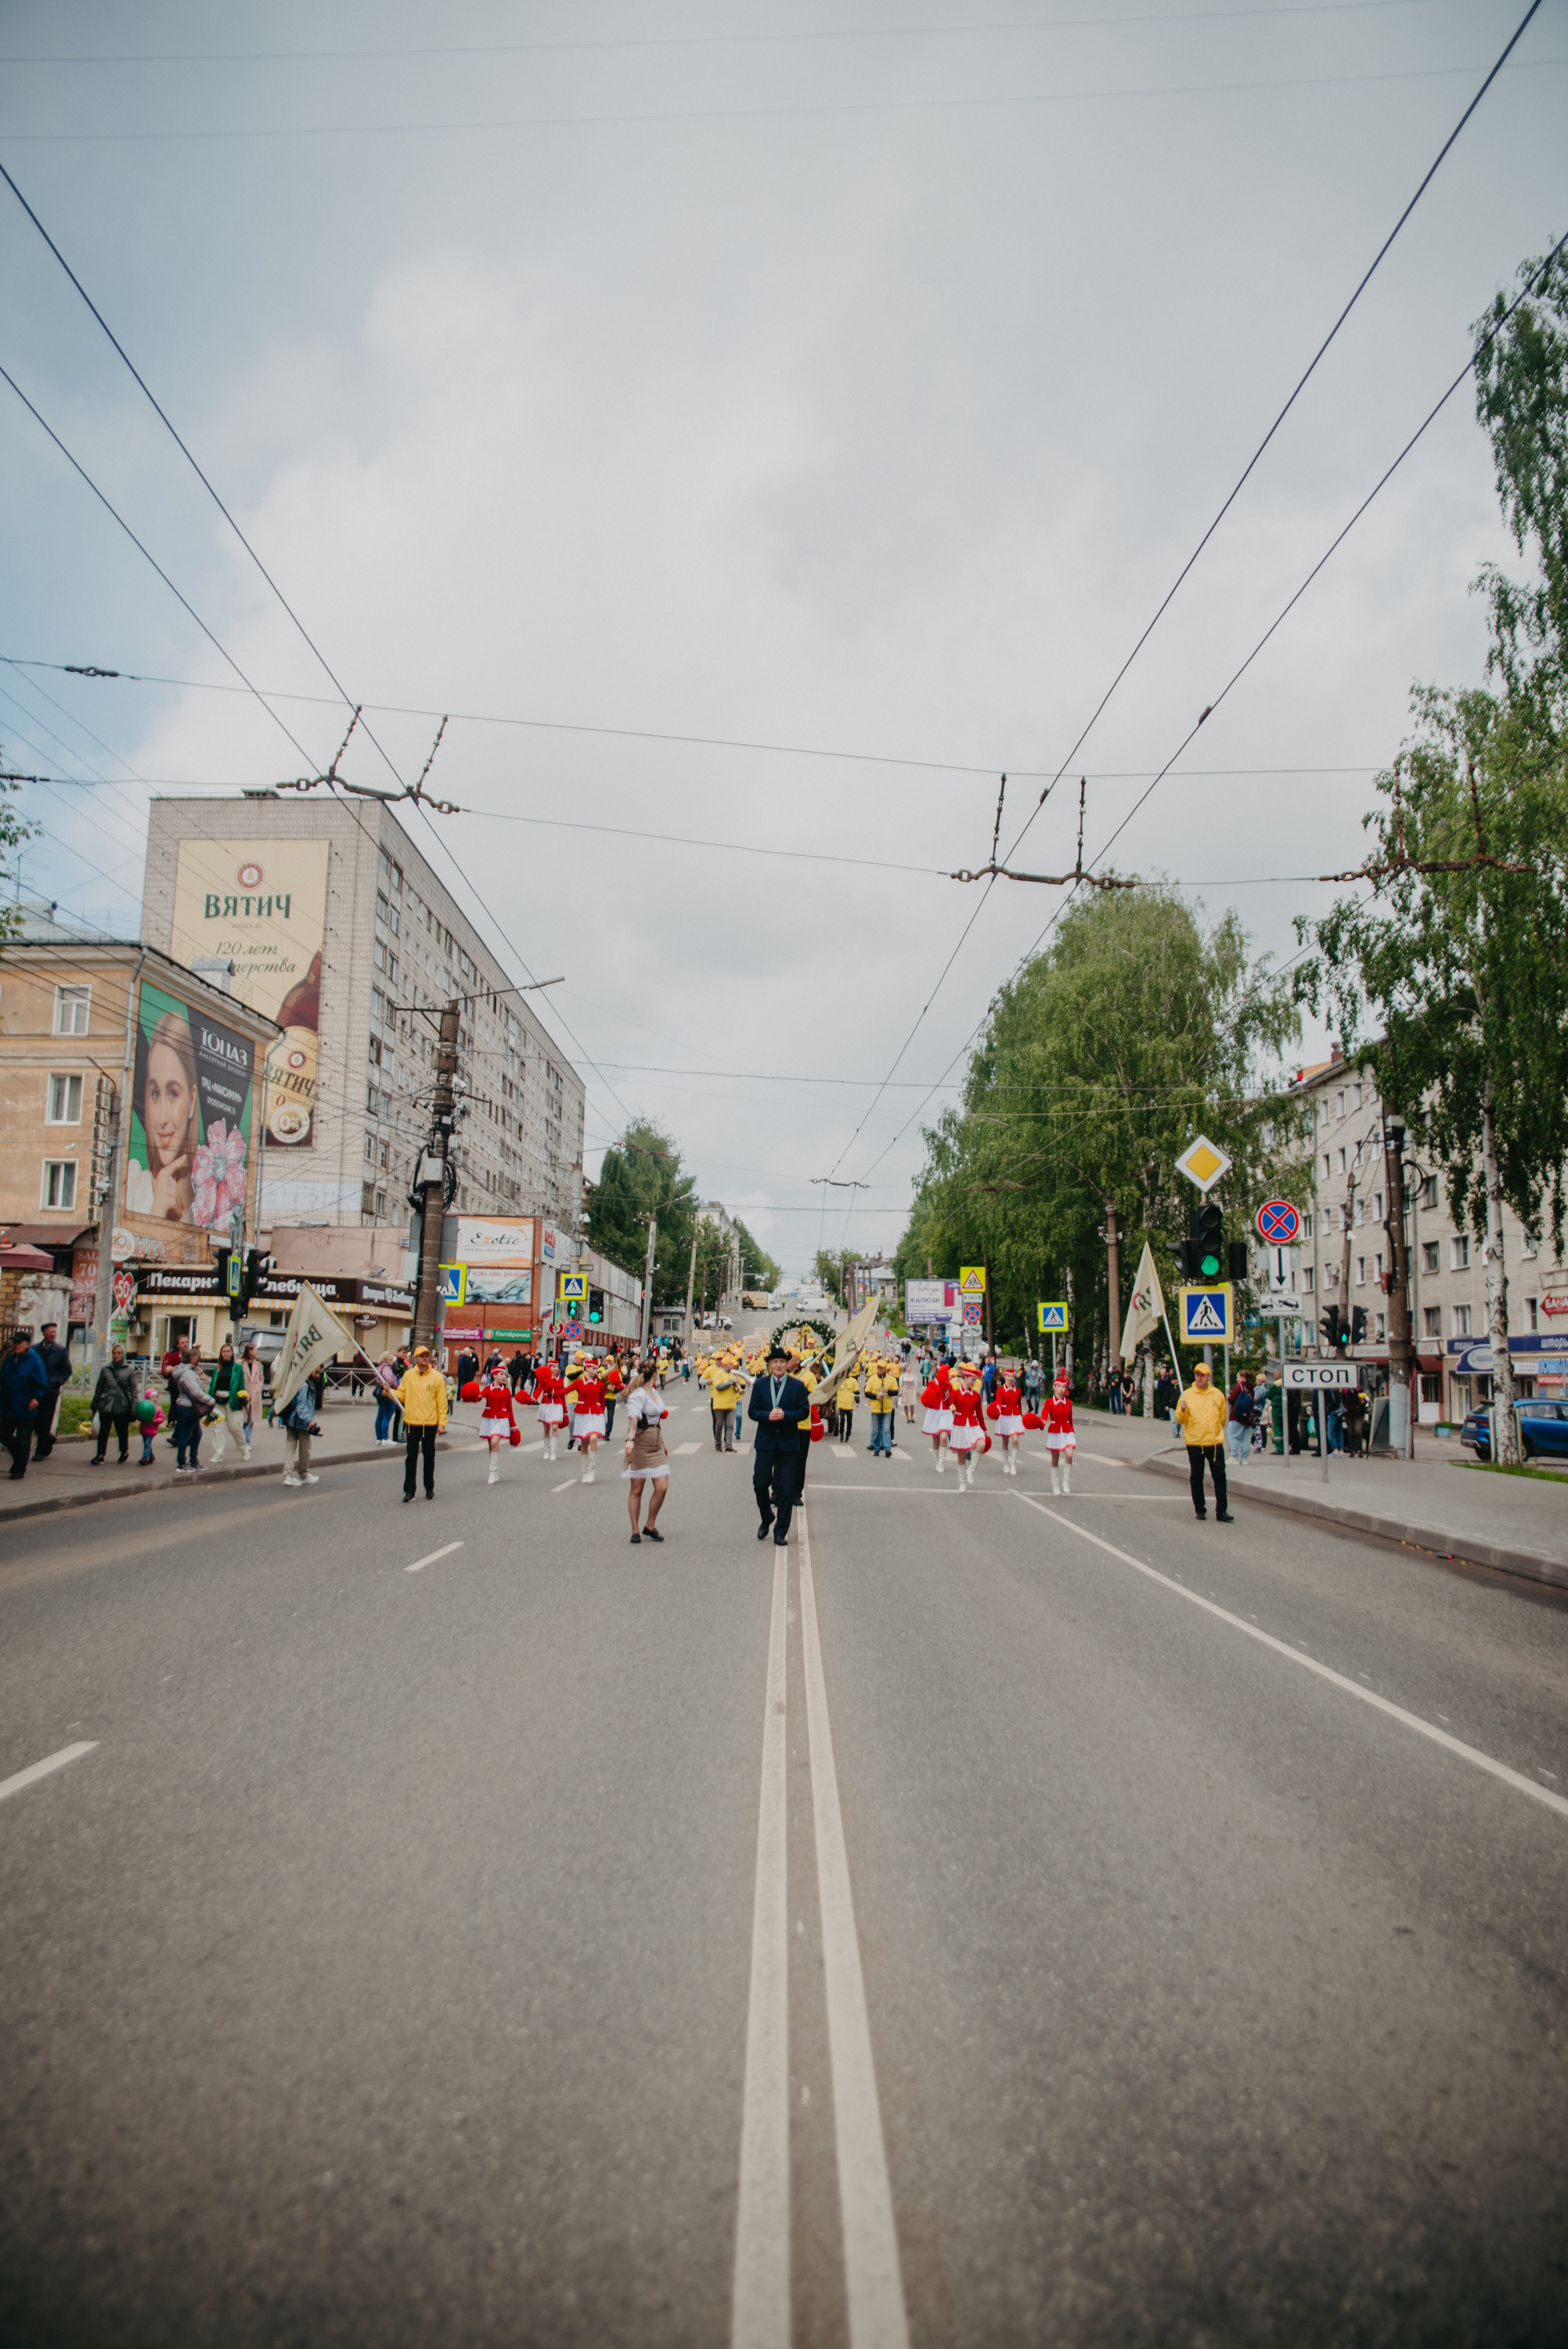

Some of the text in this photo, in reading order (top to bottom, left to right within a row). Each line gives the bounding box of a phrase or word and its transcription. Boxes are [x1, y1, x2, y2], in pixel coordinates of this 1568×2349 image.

[204, 893, 291, 918] ВЯТИЧ
[215, 941, 278, 955] 120 лет
[200, 1027, 248, 1066] ТОПАЗ
[258, 1277, 336, 1296] лебнца
[444, 1327, 479, 1337] отоКопиЦентр
[1292, 1369, 1349, 1383] СТОП
